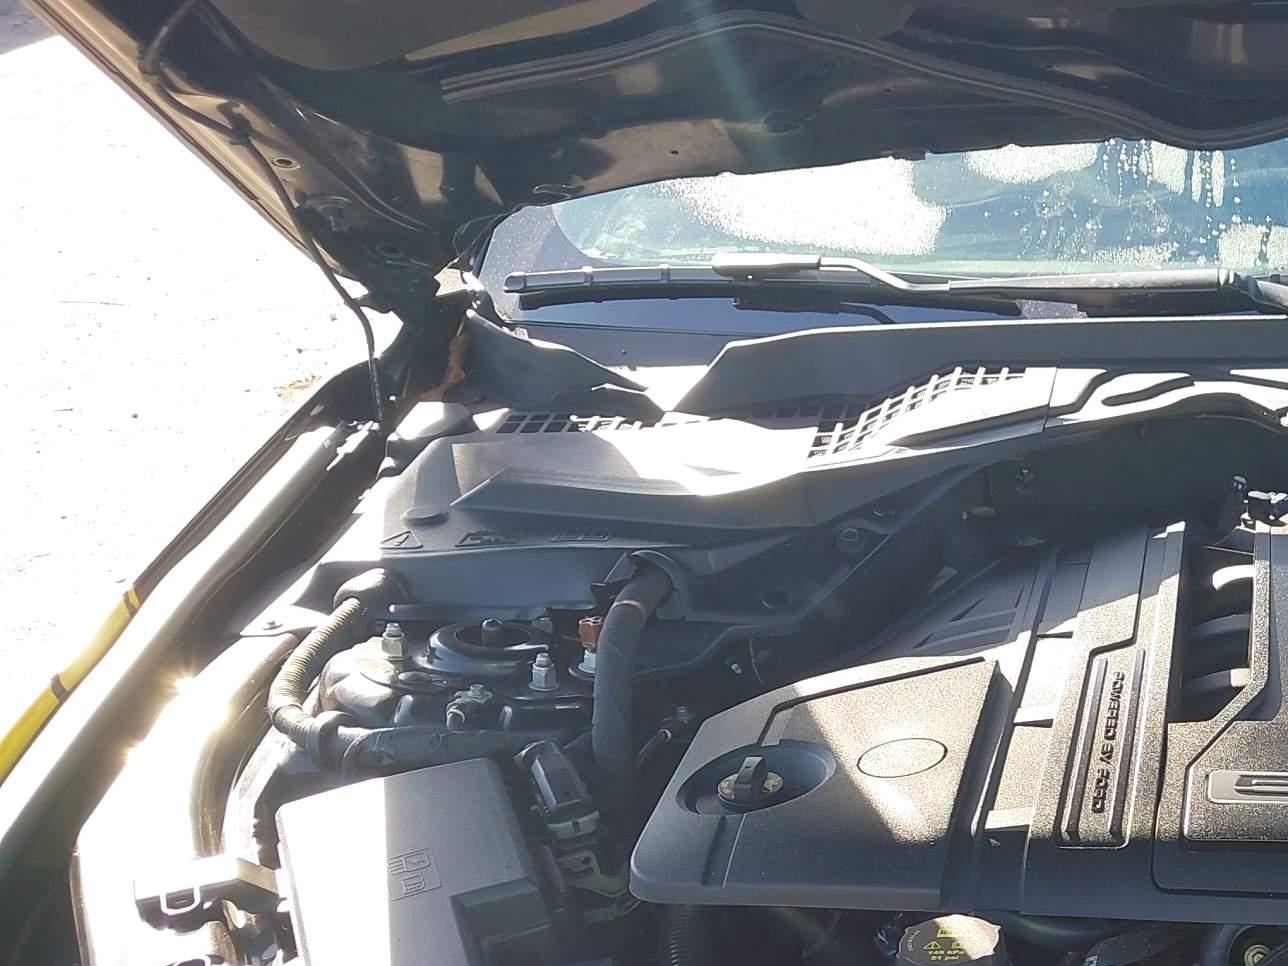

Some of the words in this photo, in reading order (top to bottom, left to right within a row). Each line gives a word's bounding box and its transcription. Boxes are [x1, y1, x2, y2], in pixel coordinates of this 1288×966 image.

[1103, 671, 1125, 741] POWERED
[1099, 743, 1114, 765] BY
[1091, 768, 1111, 814] FORD
